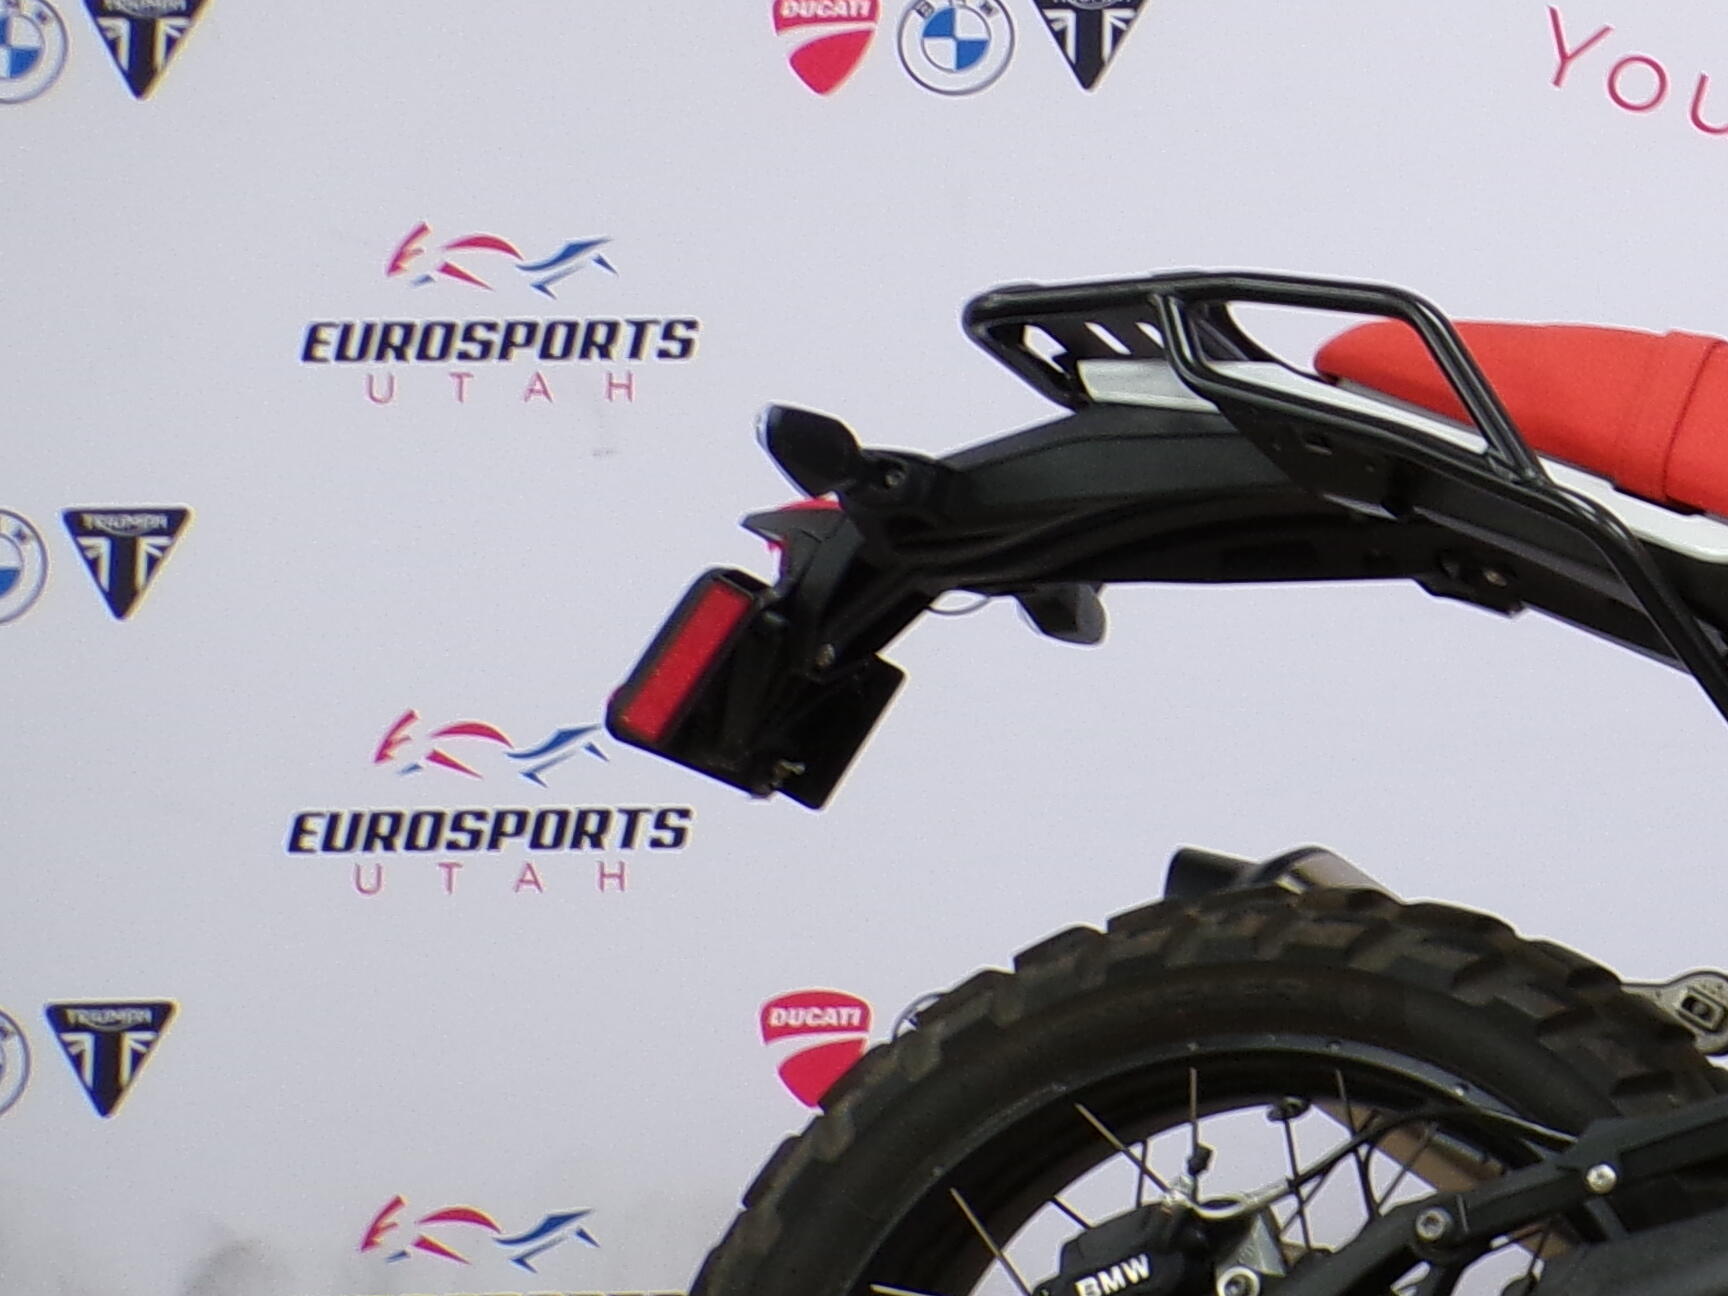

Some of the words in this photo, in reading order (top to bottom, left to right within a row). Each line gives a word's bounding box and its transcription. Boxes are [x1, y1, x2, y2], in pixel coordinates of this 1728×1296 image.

[302, 320, 698, 362] EUROSPORTS
[365, 371, 636, 404] UTAH
[288, 808, 691, 853] EUROSPORTS
[353, 861, 628, 896] UTAH
[768, 1006, 863, 1029] DUCATI
